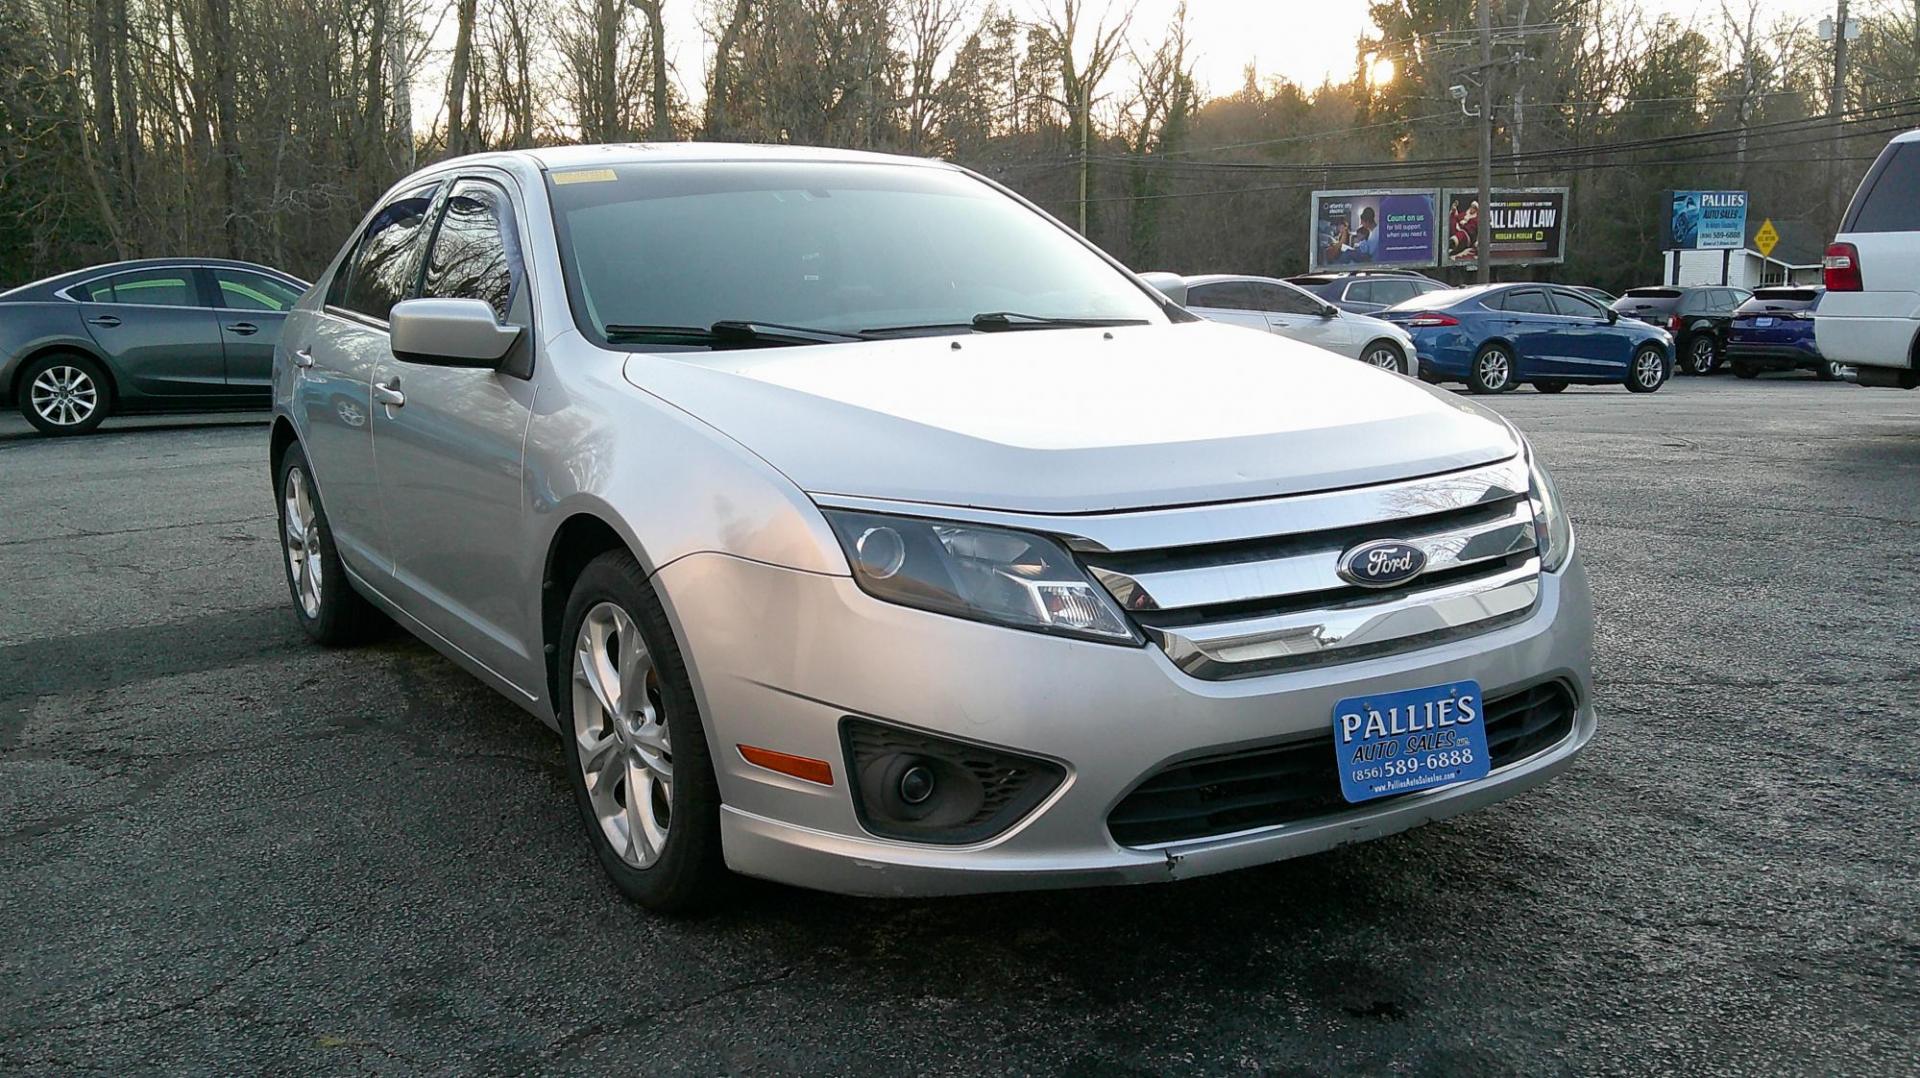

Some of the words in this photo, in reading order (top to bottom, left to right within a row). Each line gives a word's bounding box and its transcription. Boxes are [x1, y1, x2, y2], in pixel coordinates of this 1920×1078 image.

[1702, 194, 1745, 207] PALLIES
[1387, 214, 1406, 222] Count
[1508, 209, 1531, 229] LAW
[1532, 209, 1556, 228] LAW
[1703, 209, 1720, 219] AUTO
[1720, 209, 1738, 219] SALES
[1367, 547, 1413, 576] Ford
[1341, 695, 1476, 744] PALLIES
[1352, 739, 1399, 764] AUTO
[1404, 729, 1456, 755] SALES
[1384, 748, 1474, 778] 589-6888
